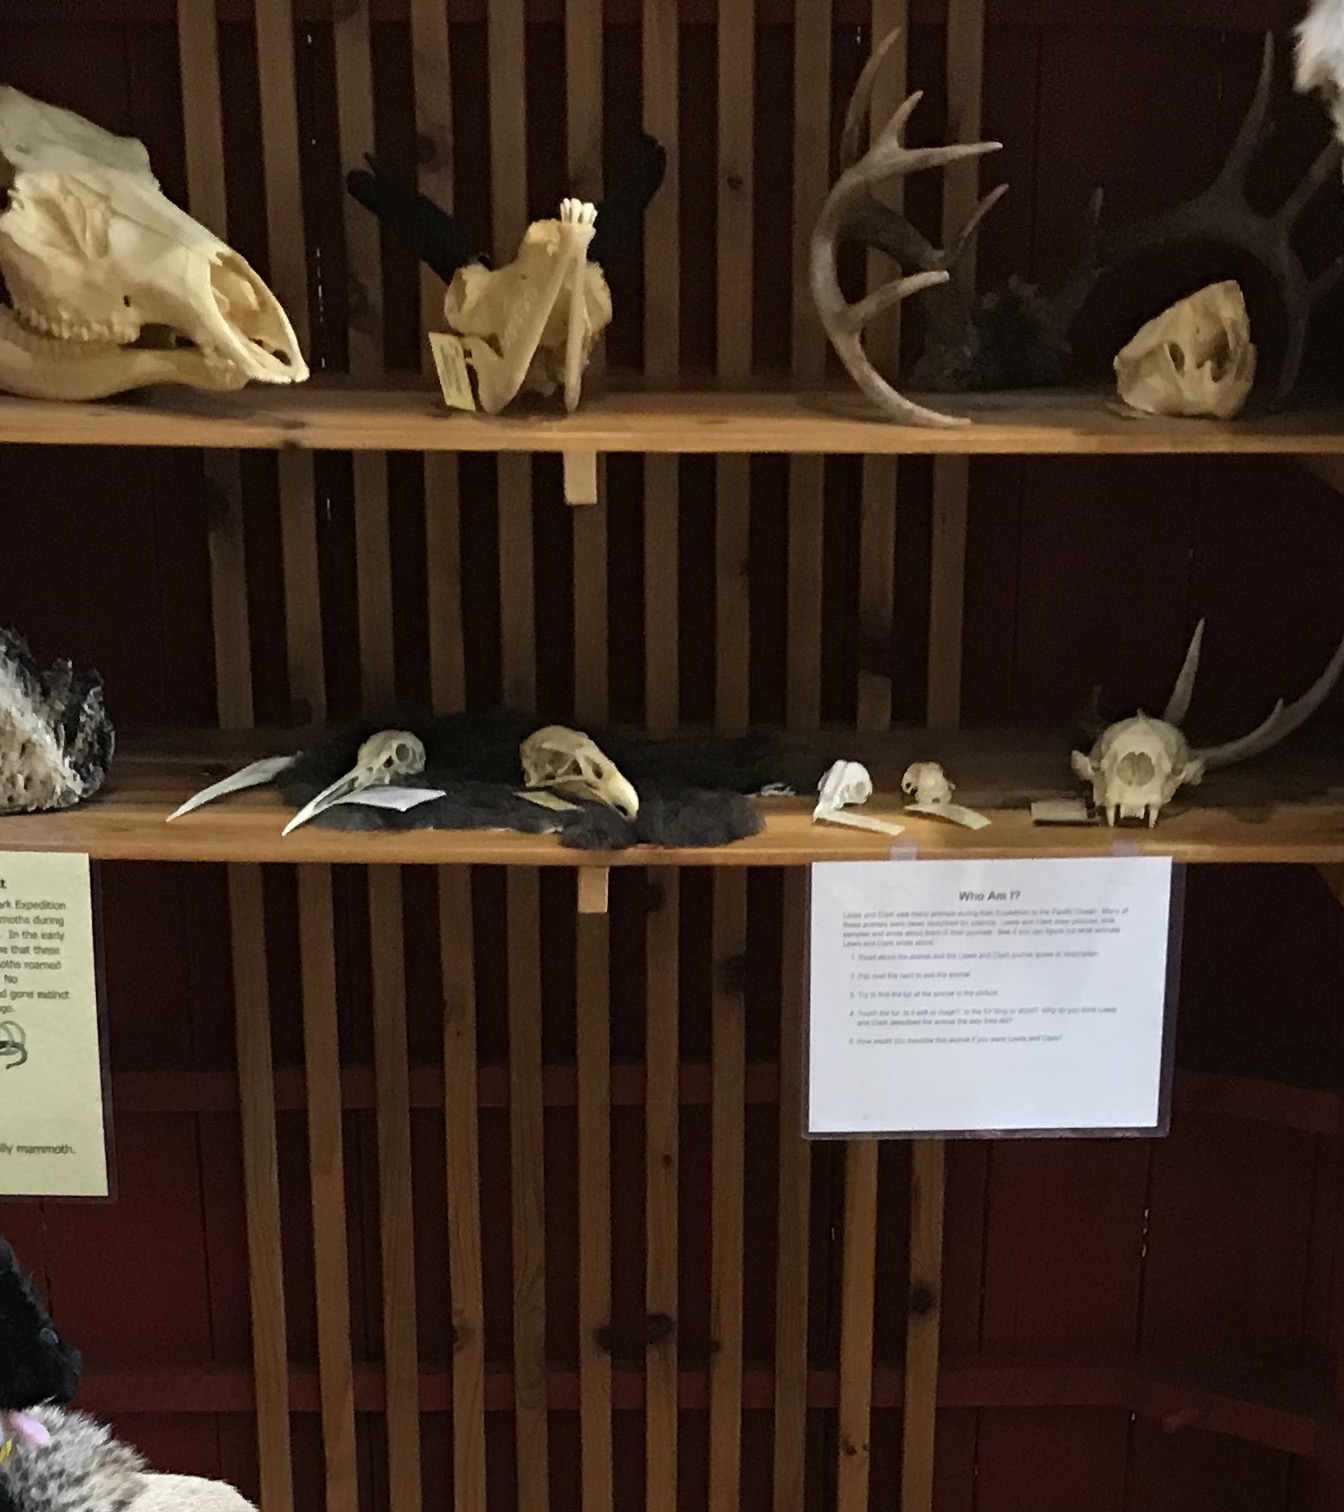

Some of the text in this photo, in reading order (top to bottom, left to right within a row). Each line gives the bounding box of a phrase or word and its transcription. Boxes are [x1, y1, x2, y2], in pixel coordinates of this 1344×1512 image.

[958, 890, 986, 901] Who
[987, 889, 1007, 901] Am
[14, 899, 67, 911] Expedition
[32, 913, 65, 927] during
[21, 929, 38, 940] the
[41, 931, 65, 942] early
[11, 944, 30, 955] that
[3, 973, 19, 984] No
[16, 1143, 77, 1155] mammoth.
